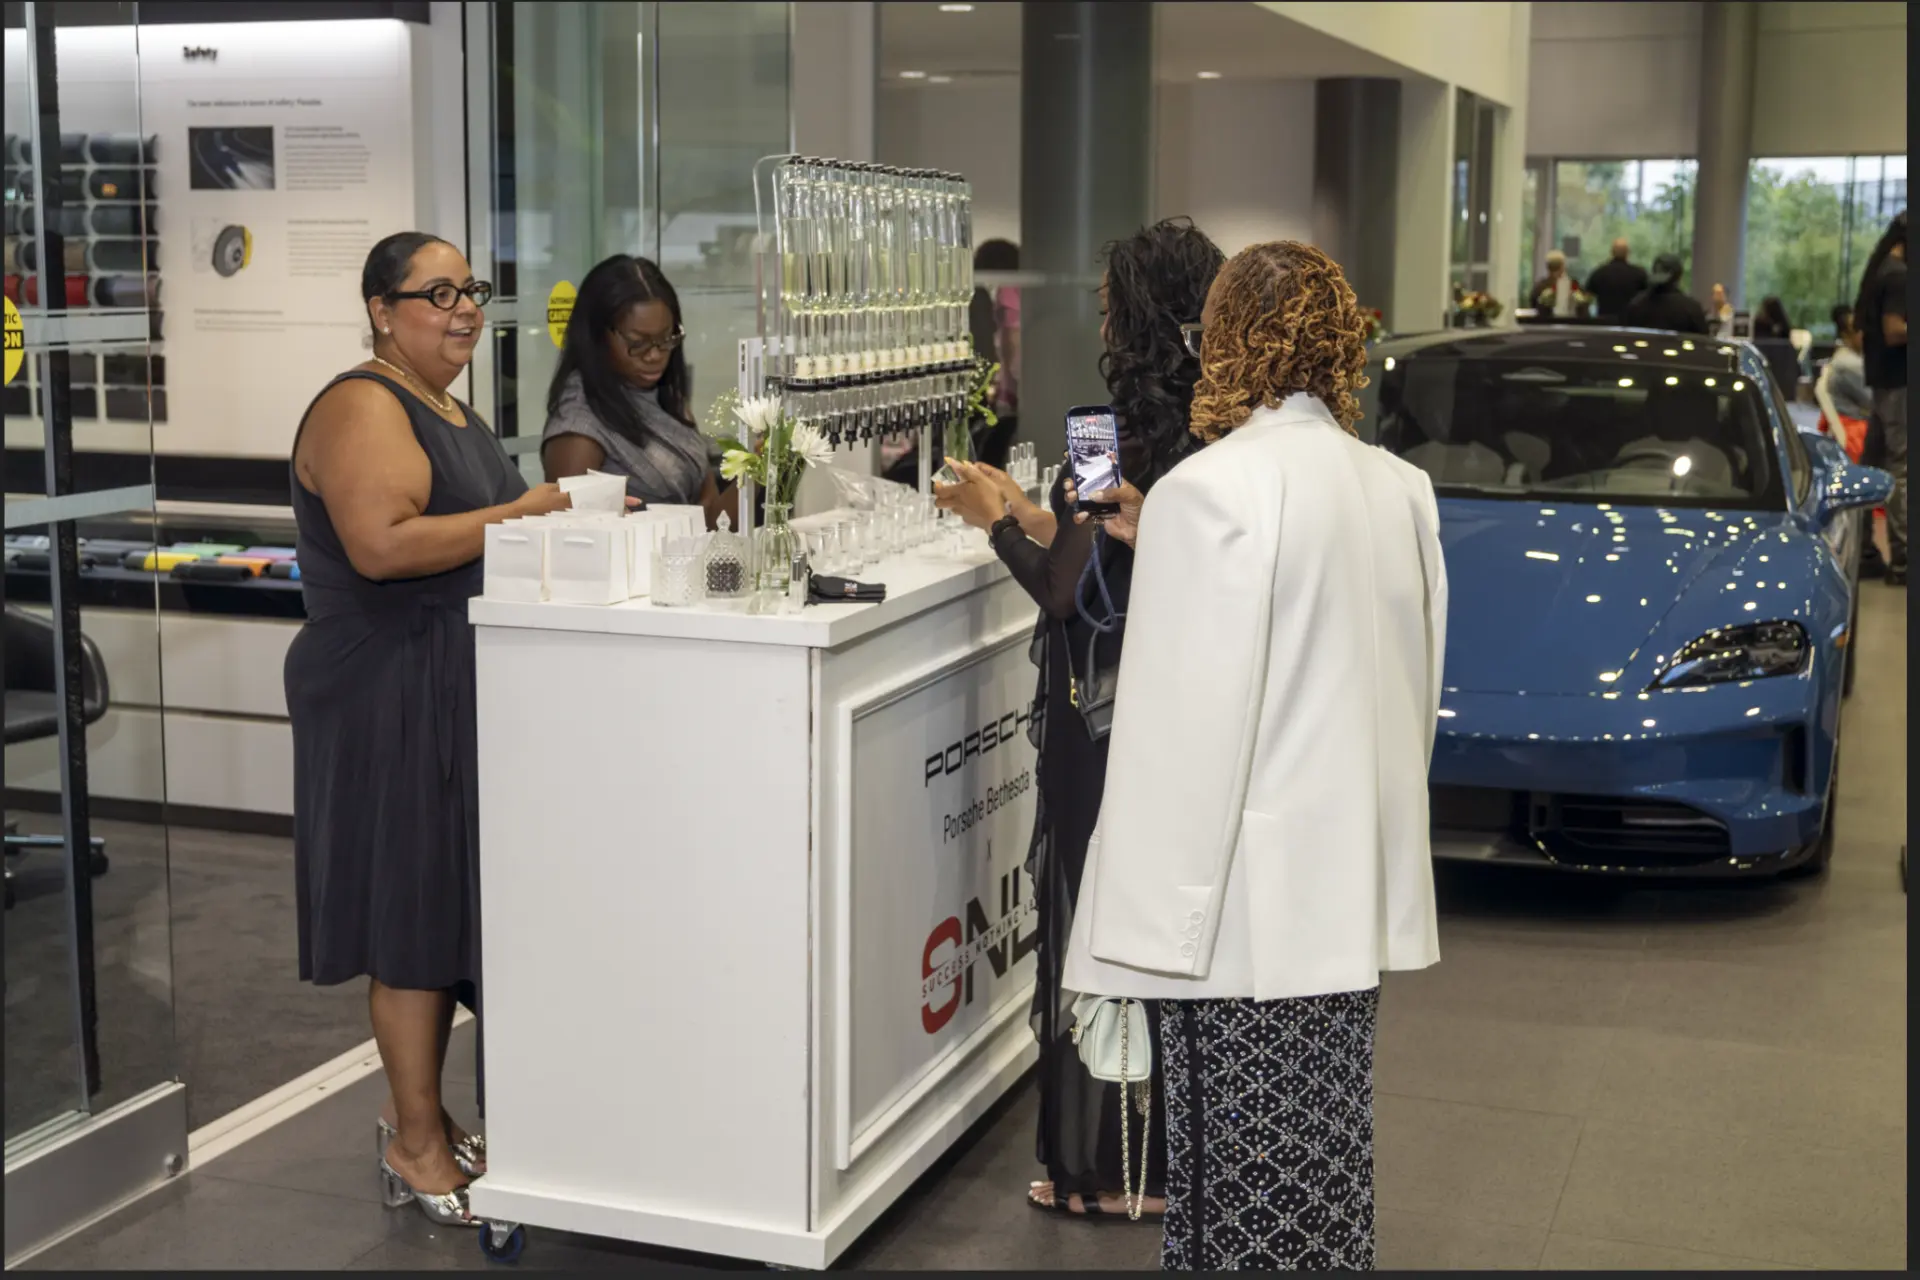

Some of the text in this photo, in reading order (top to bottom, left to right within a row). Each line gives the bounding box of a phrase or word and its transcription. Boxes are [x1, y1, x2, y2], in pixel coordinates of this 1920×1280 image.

[183, 46, 218, 61] Safety
[925, 702, 1034, 788] PORSCH
[943, 767, 1030, 844] Porsche Bethesda
[922, 951, 969, 998] SUCCESS
[975, 911, 1019, 954] NOTHING
